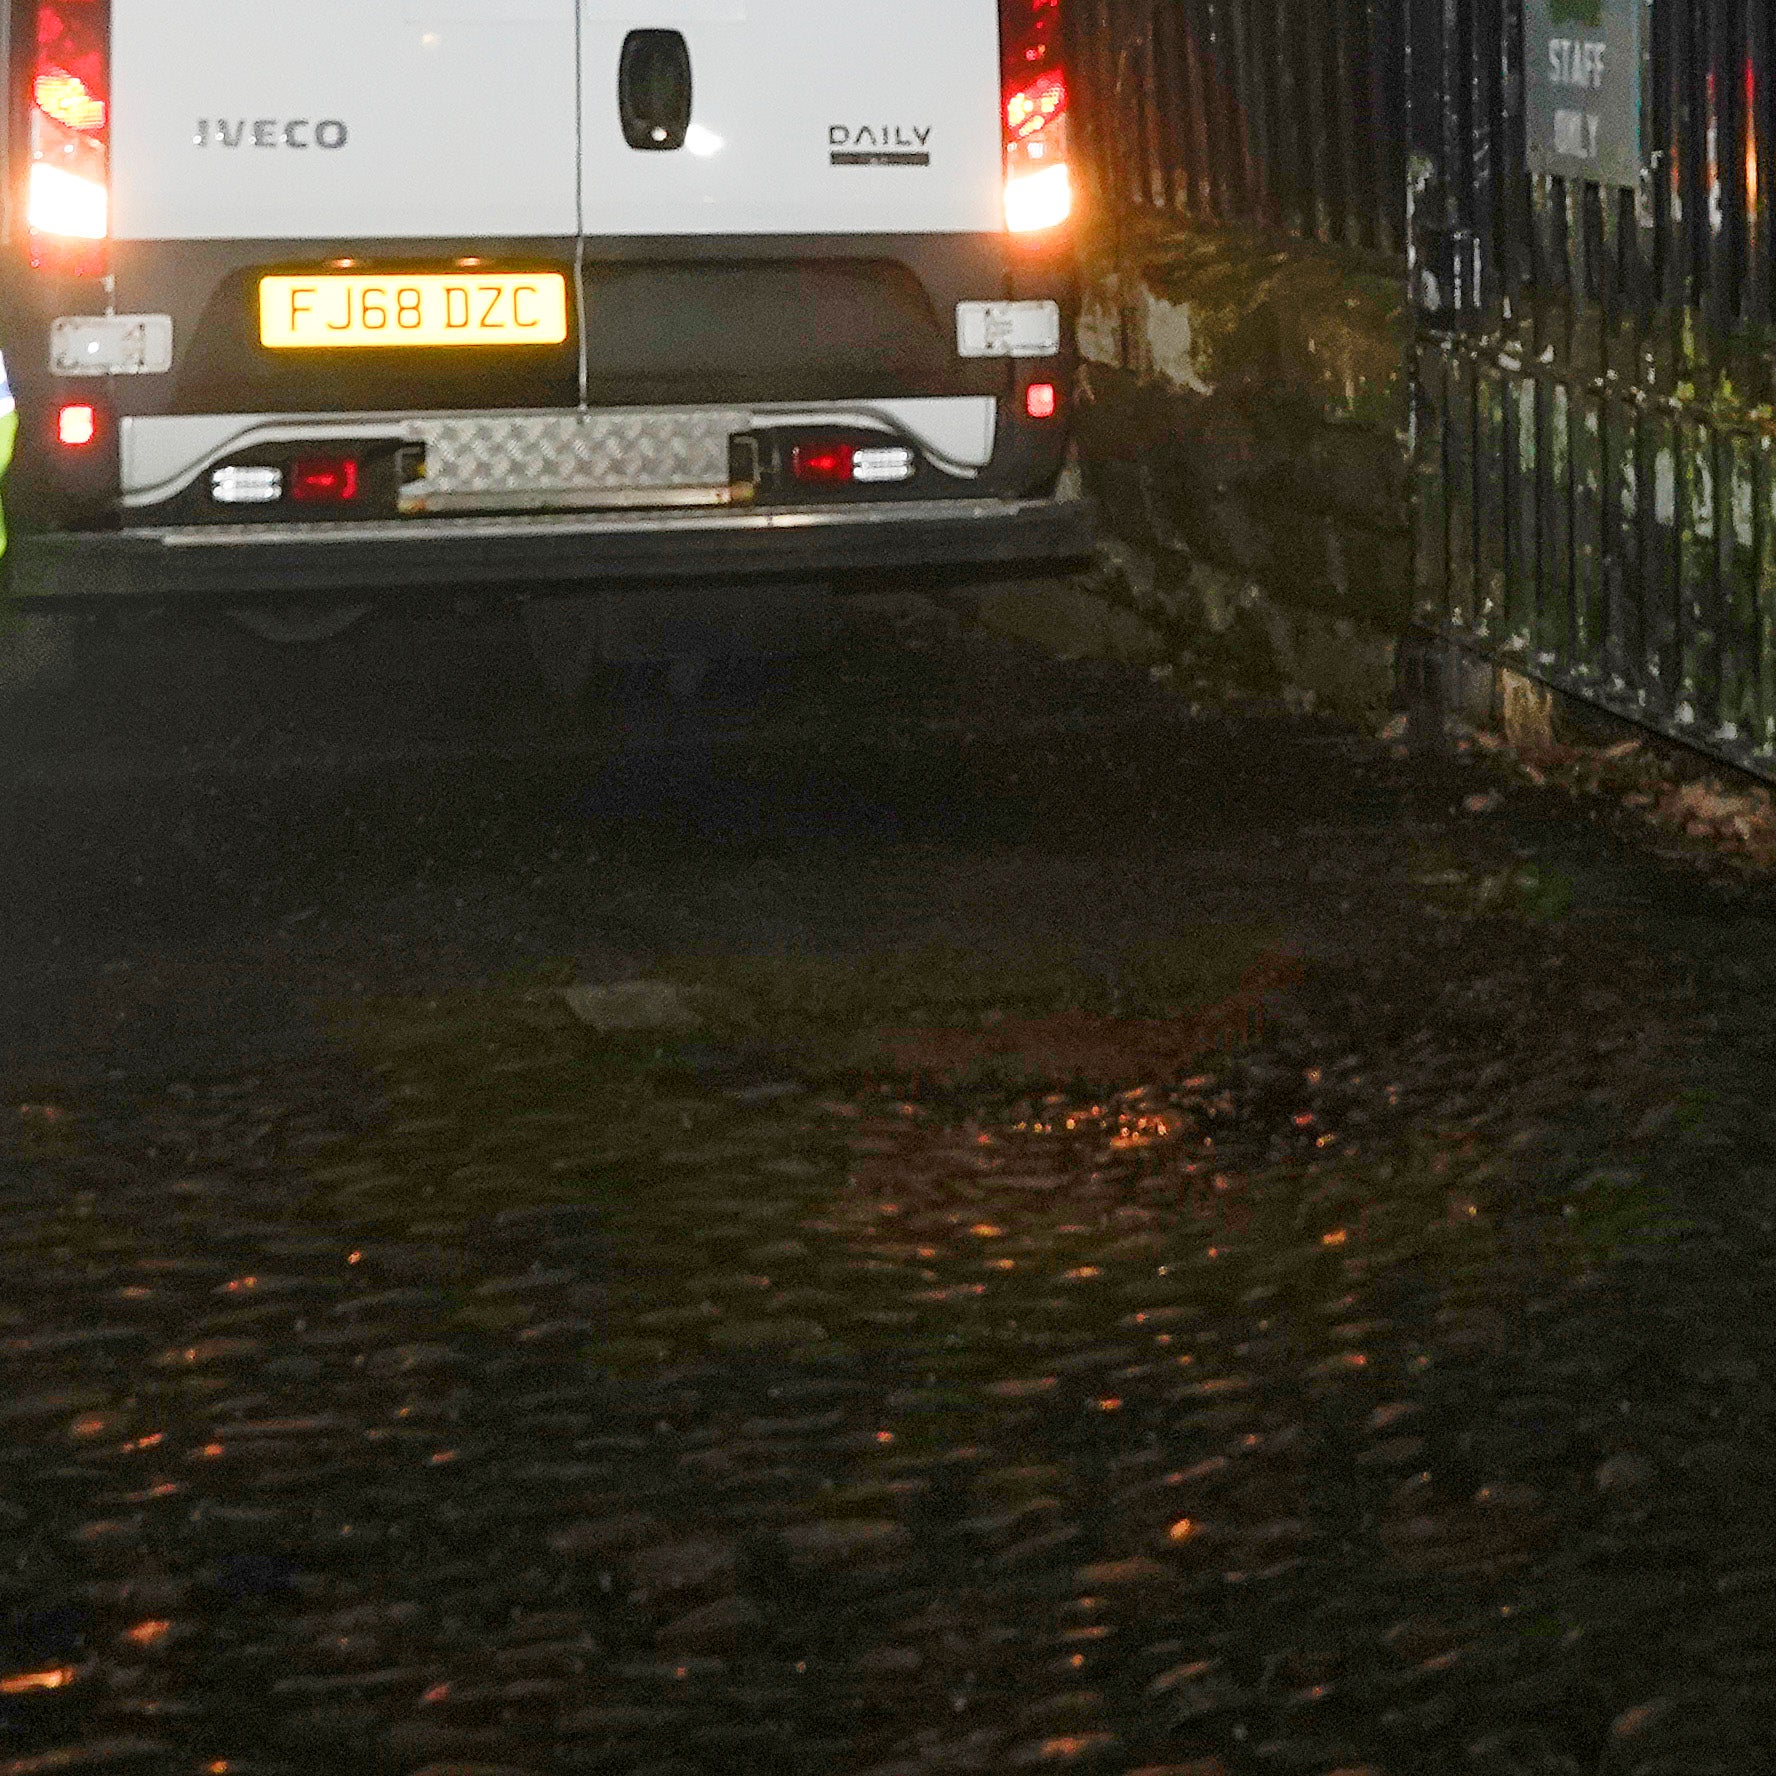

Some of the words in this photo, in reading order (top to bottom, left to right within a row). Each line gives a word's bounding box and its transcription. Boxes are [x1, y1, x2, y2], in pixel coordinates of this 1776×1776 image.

[194, 118, 349, 149] IVECO
[828, 124, 932, 146] DAILY
[290, 286, 422, 332] FJ68
[443, 285, 540, 329] DZC
